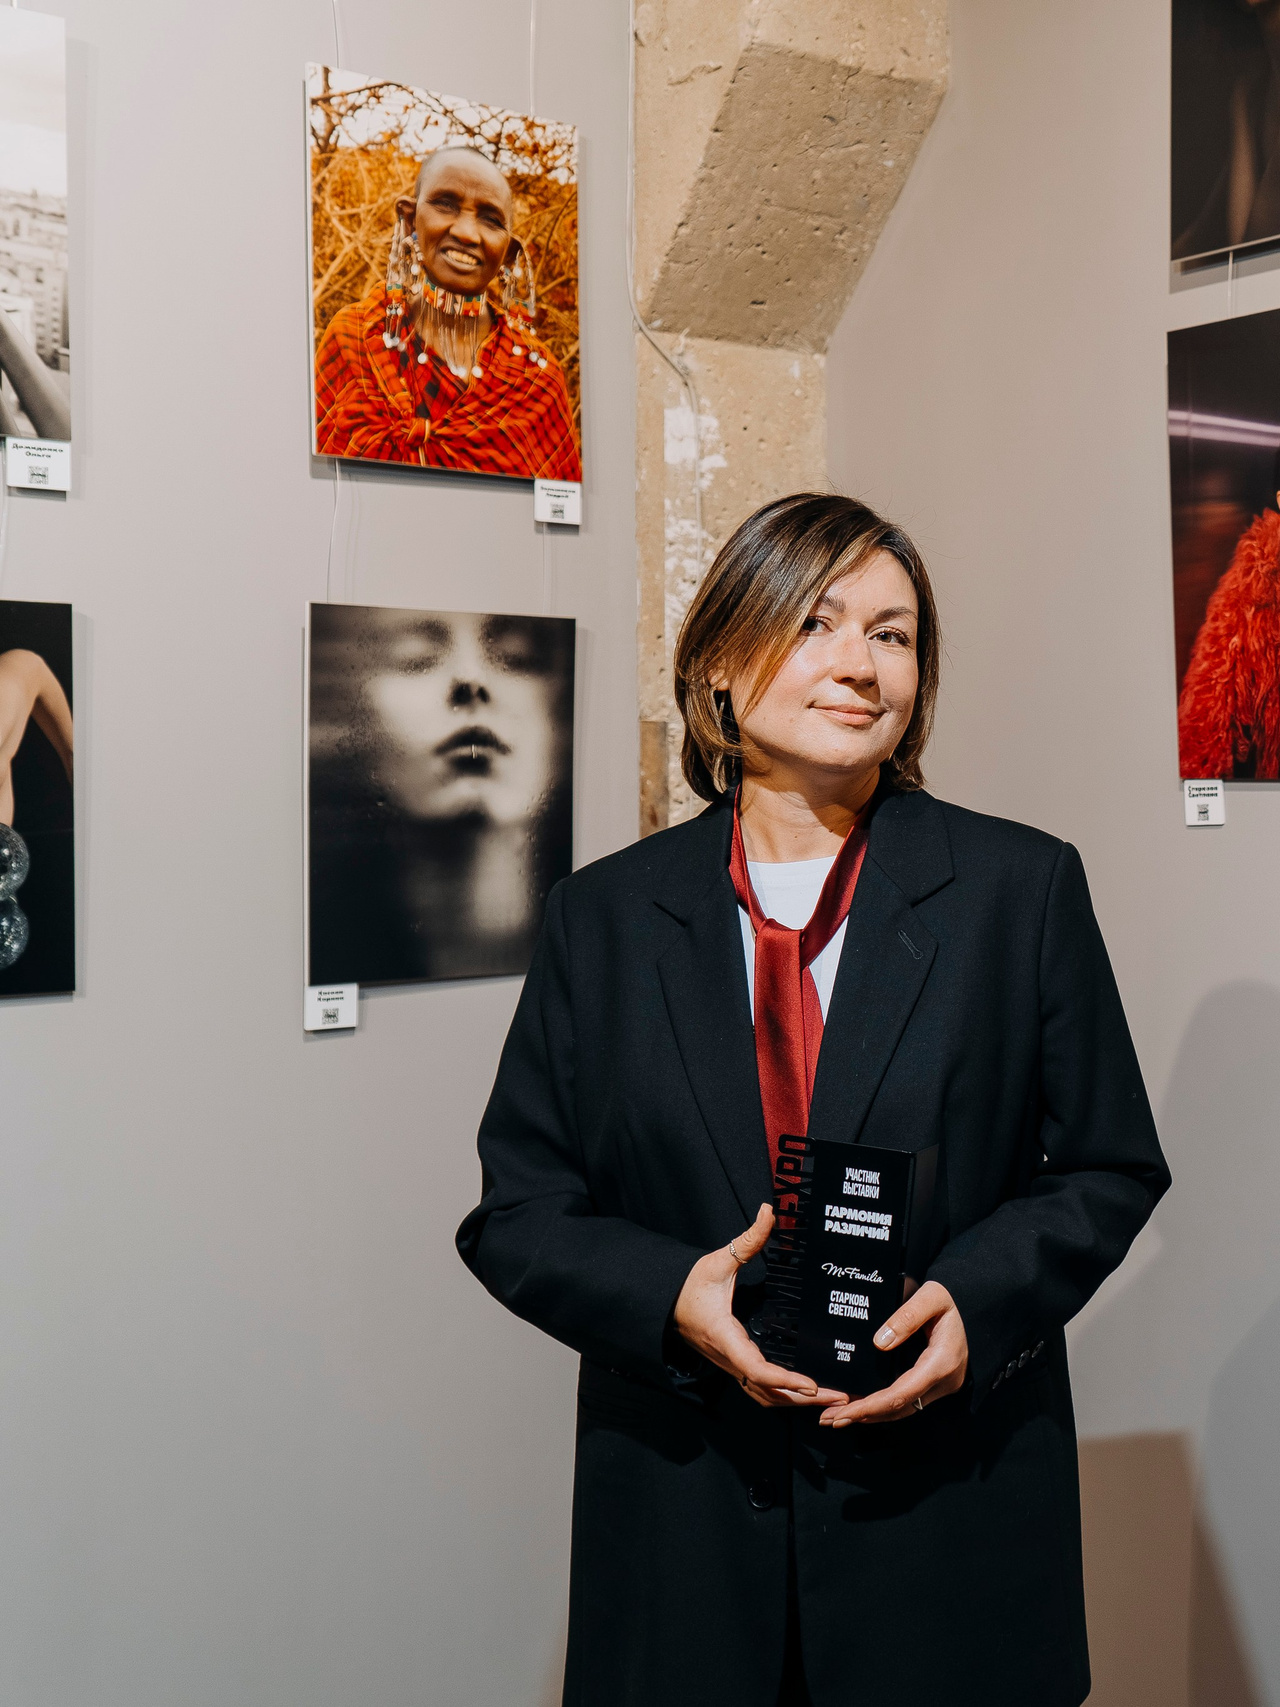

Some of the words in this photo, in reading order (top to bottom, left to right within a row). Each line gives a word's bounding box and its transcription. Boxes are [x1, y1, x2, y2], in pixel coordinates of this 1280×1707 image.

[845, 1167, 881, 1185] УЧАСТНИК
[842, 1181, 880, 1199] ВЫСТАВКИ
[825, 1204, 893, 1226] ГАРМОНИЯ
[824, 1219, 890, 1241] РАЗЛИЧИЙ
[830, 1290, 869, 1308] СТАРКОВА
[828, 1302, 869, 1321] СВЕТЛАНА
[834, 1339, 855, 1352] Москва
